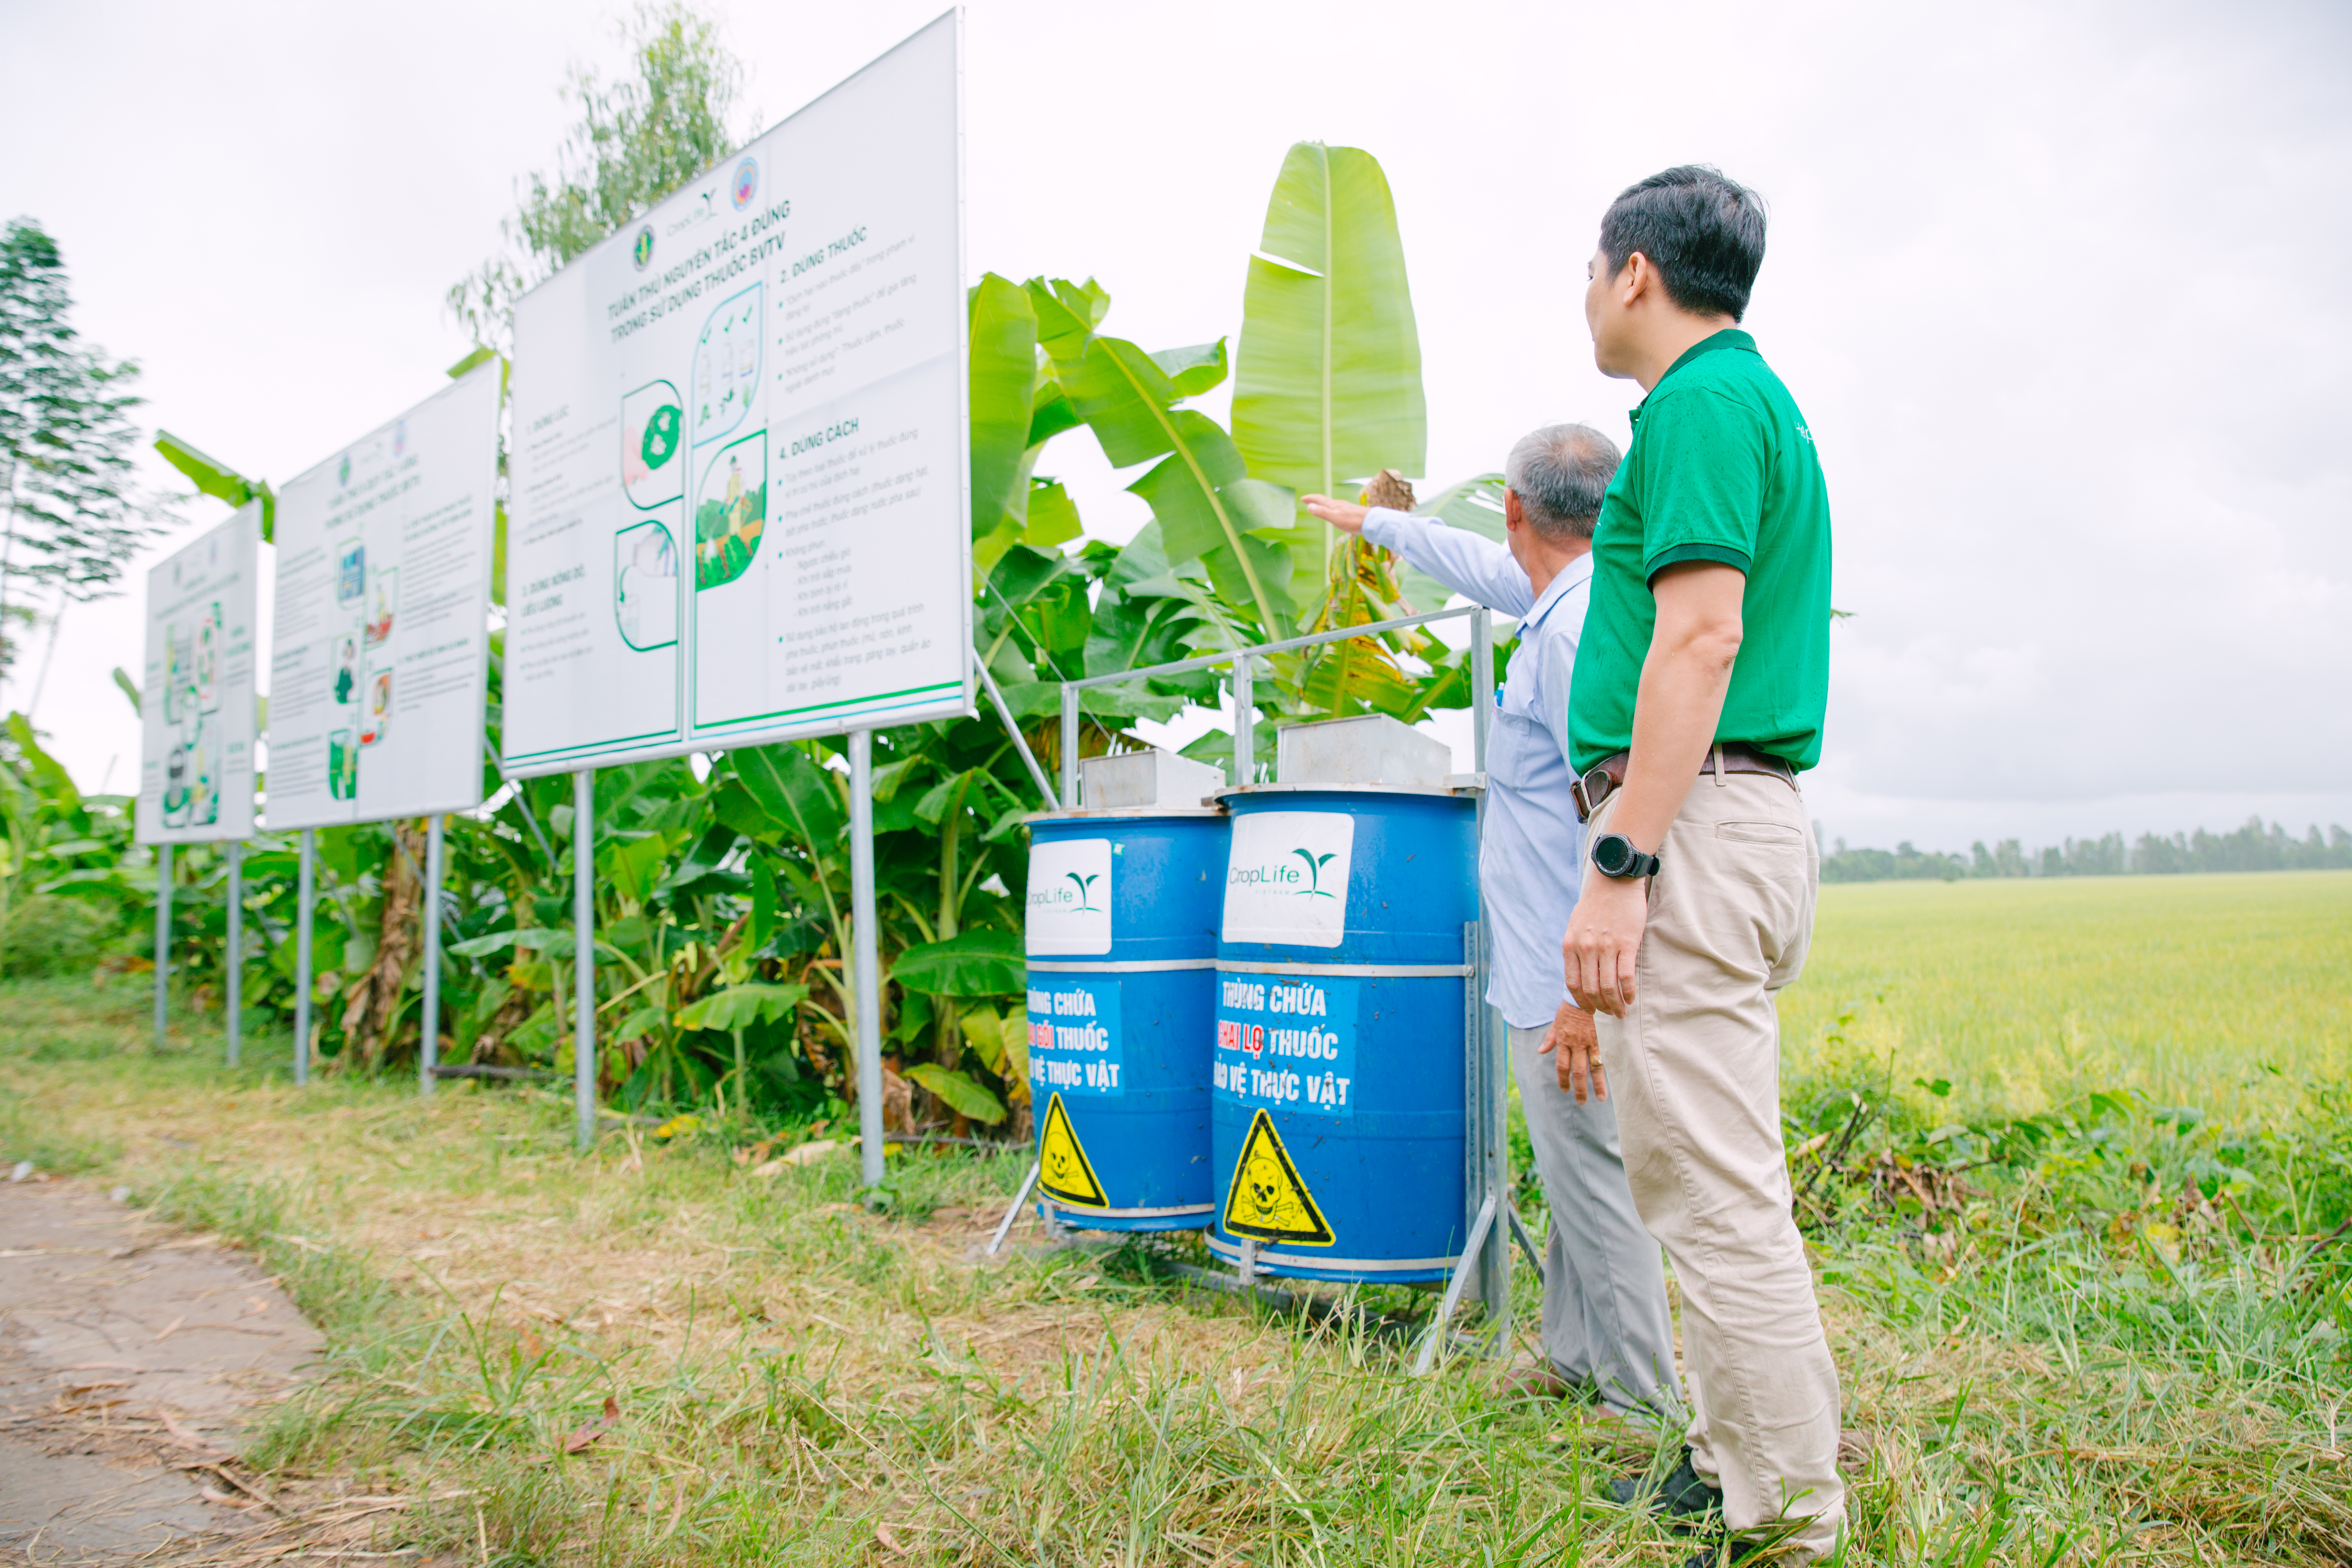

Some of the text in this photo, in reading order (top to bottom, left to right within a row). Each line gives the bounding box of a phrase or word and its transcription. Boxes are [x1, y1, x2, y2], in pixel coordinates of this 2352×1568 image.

[740, 225, 748, 241] 4
[780, 270, 789, 284] 2.
[828, 226, 867, 258] THUỐC
[611, 311, 647, 341] TRONG
[704, 254, 747, 290] THUỐC
[750, 232, 785, 266] BVTV
[779, 448, 789, 459] 4.
[826, 418, 858, 443] CÁCH
[1229, 865, 1299, 886] CropLife
[1054, 988, 1096, 1016] CHỨA
[1223, 977, 1326, 1016] THÙNG CHỨA
[1037, 1020, 1055, 1049] GÓI
[1056, 1020, 1109, 1051] THUỐC
[1218, 1019, 1338, 1060] CHAI LỌ THUỐC
[1047, 1060, 1082, 1090] THỰC
[1085, 1059, 1120, 1092] VẬT
[1229, 1061, 1247, 1099] VỆ
[1251, 1069, 1300, 1105] THỰC
[1307, 1071, 1350, 1110] VẬT
